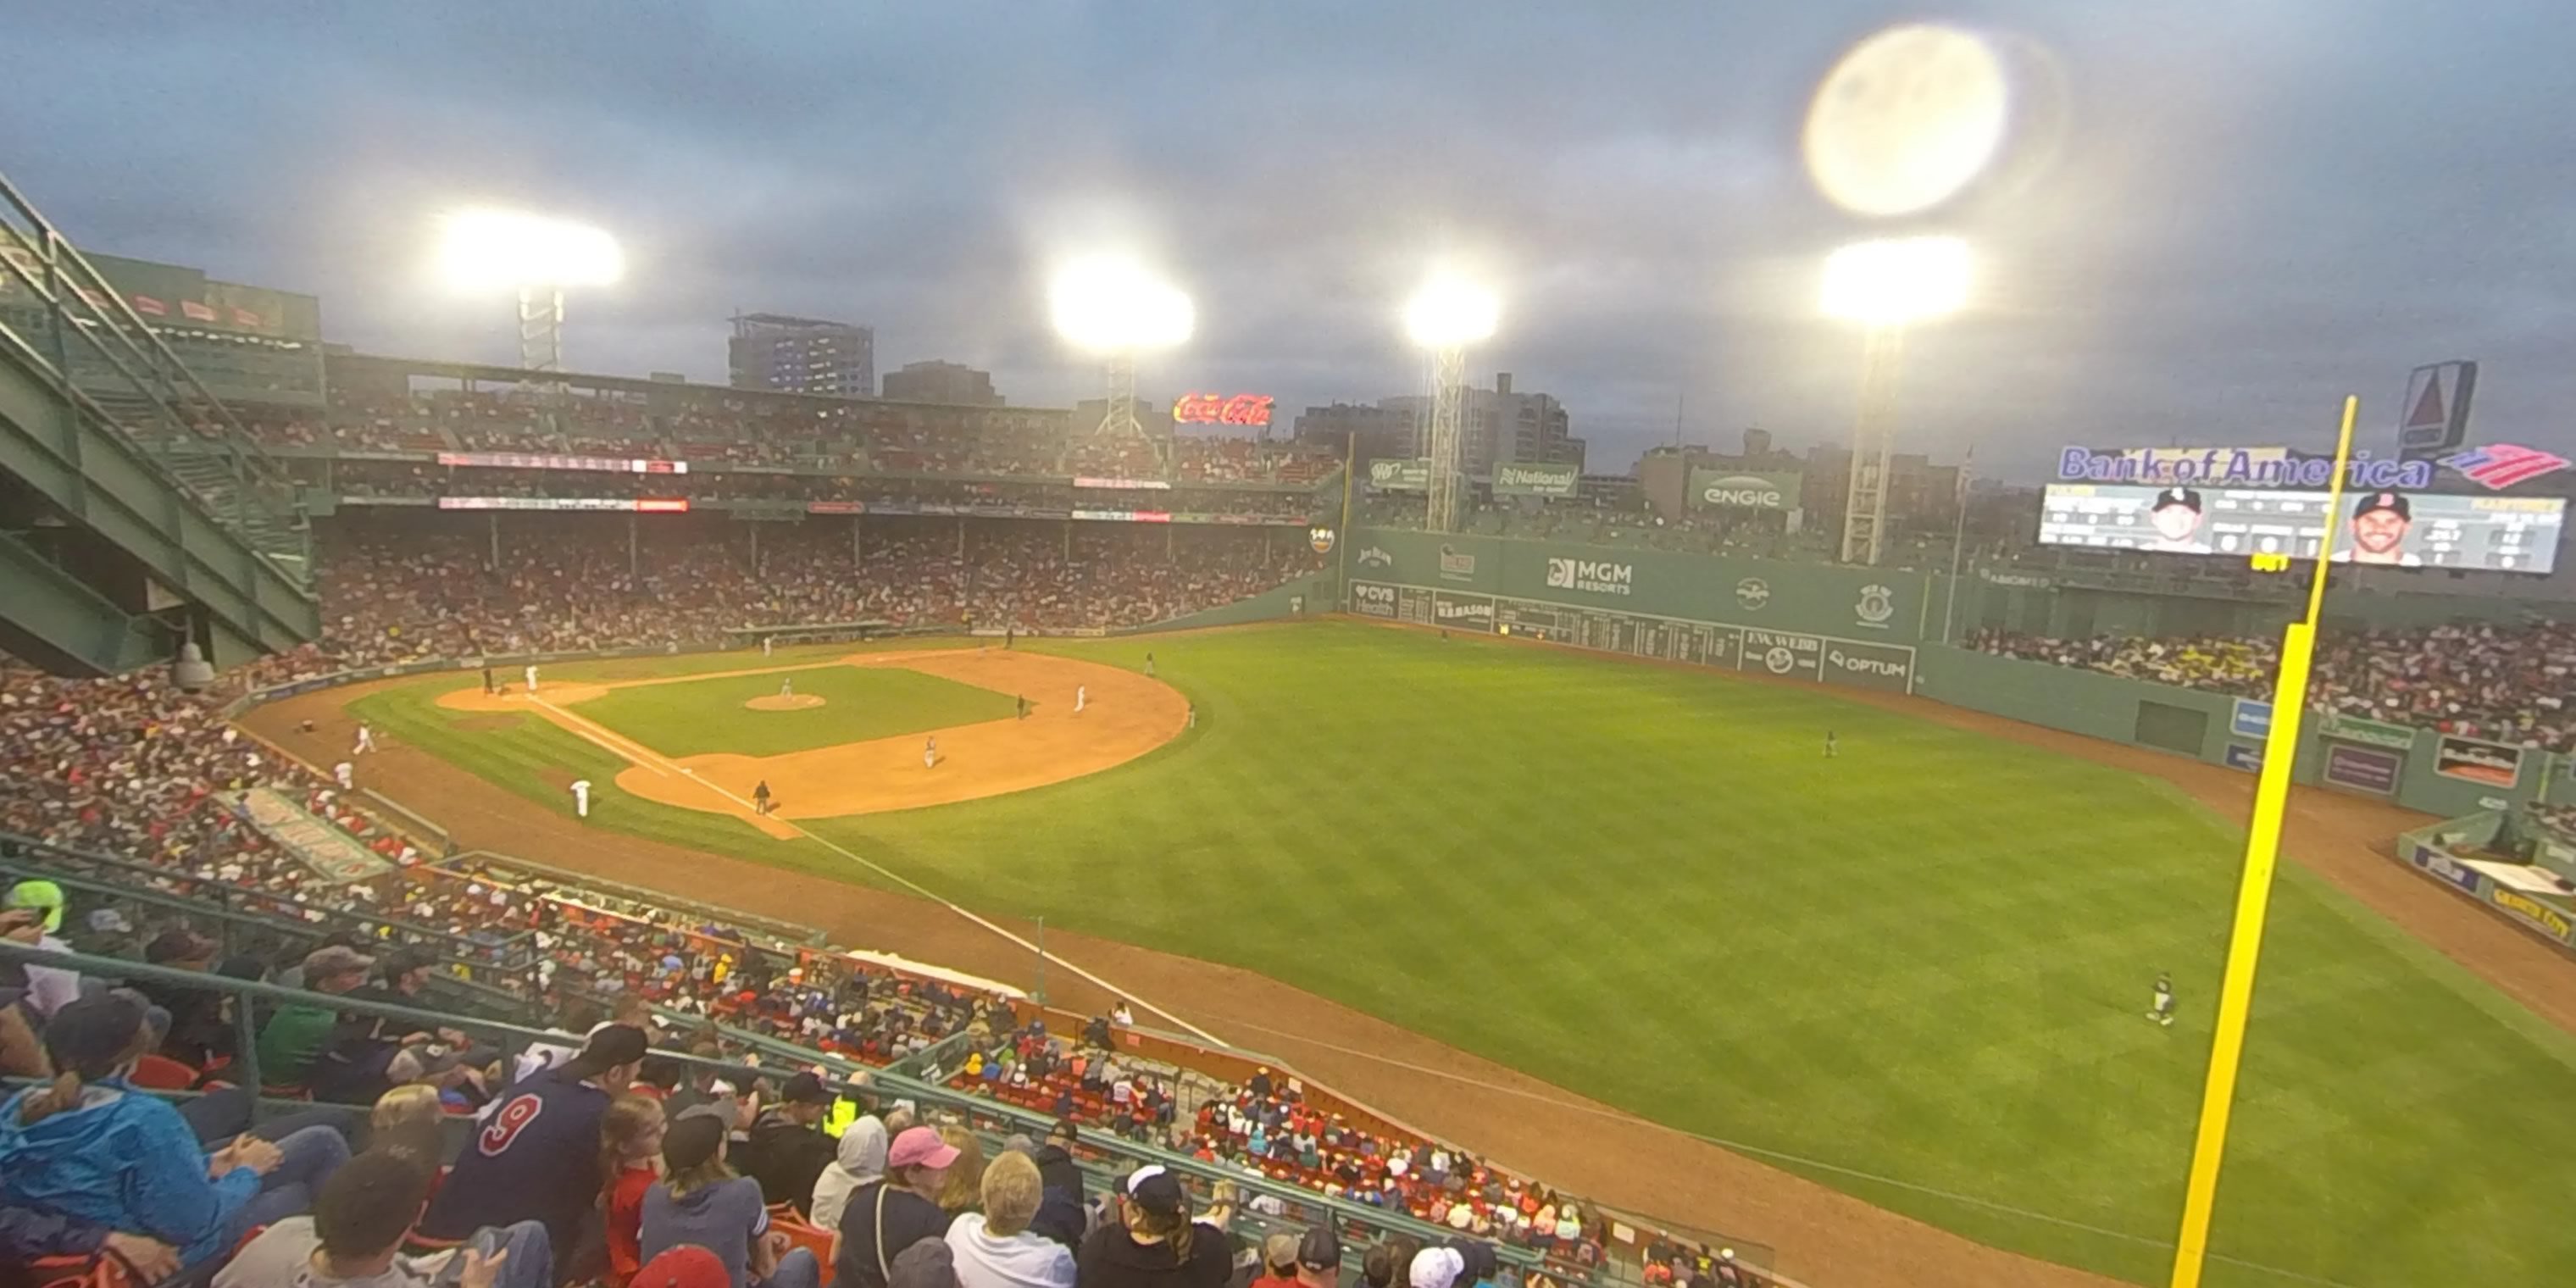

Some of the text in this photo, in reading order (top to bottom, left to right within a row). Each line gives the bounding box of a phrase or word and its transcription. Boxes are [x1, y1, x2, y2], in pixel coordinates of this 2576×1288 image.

[2058, 446, 2162, 482] Bank
[2172, 449, 2219, 481] of
[1515, 469, 1571, 487] National
[1578, 560, 1632, 584] MGM
[1368, 586, 1394, 602] CVS
[1577, 580, 1630, 596] RESORTS
[1356, 598, 1394, 616] Health
[1846, 658, 1907, 677] OPTUM
[479, 1093, 542, 1158] 9
